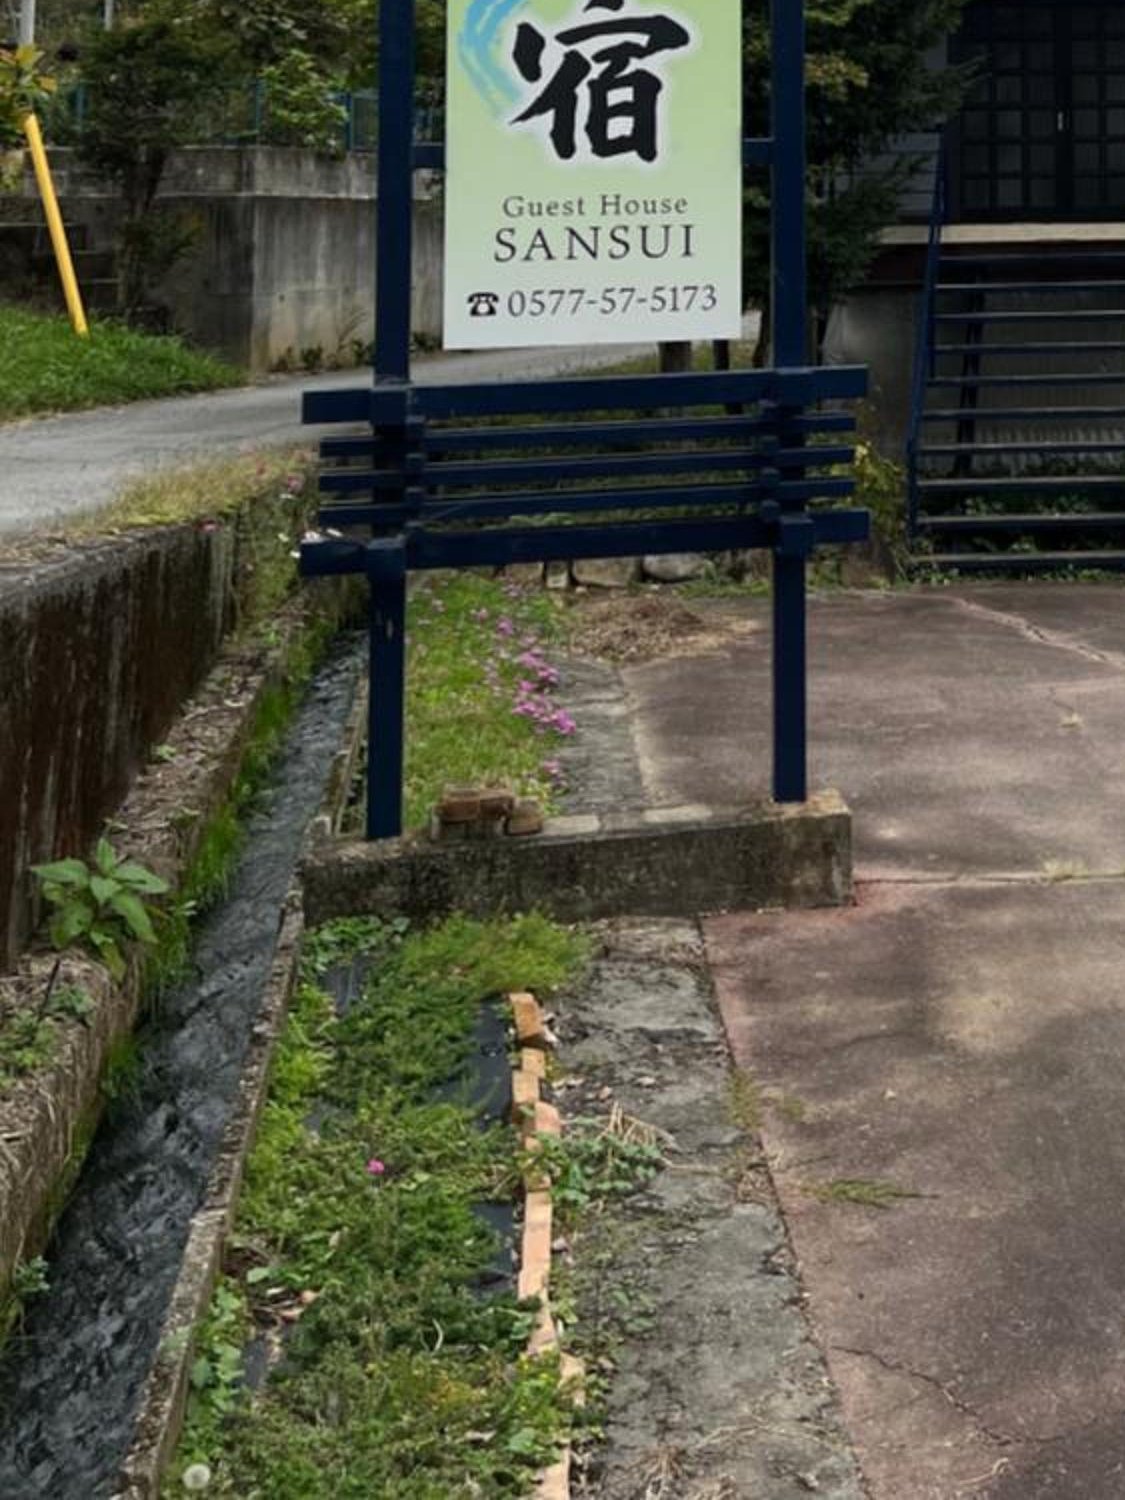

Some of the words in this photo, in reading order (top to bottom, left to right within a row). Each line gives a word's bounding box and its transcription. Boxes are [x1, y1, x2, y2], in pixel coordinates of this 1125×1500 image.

[502, 195, 586, 219] Guest
[599, 193, 689, 217] House
[493, 223, 694, 263] SANSUI
[507, 284, 718, 318] 0577-57-5173
